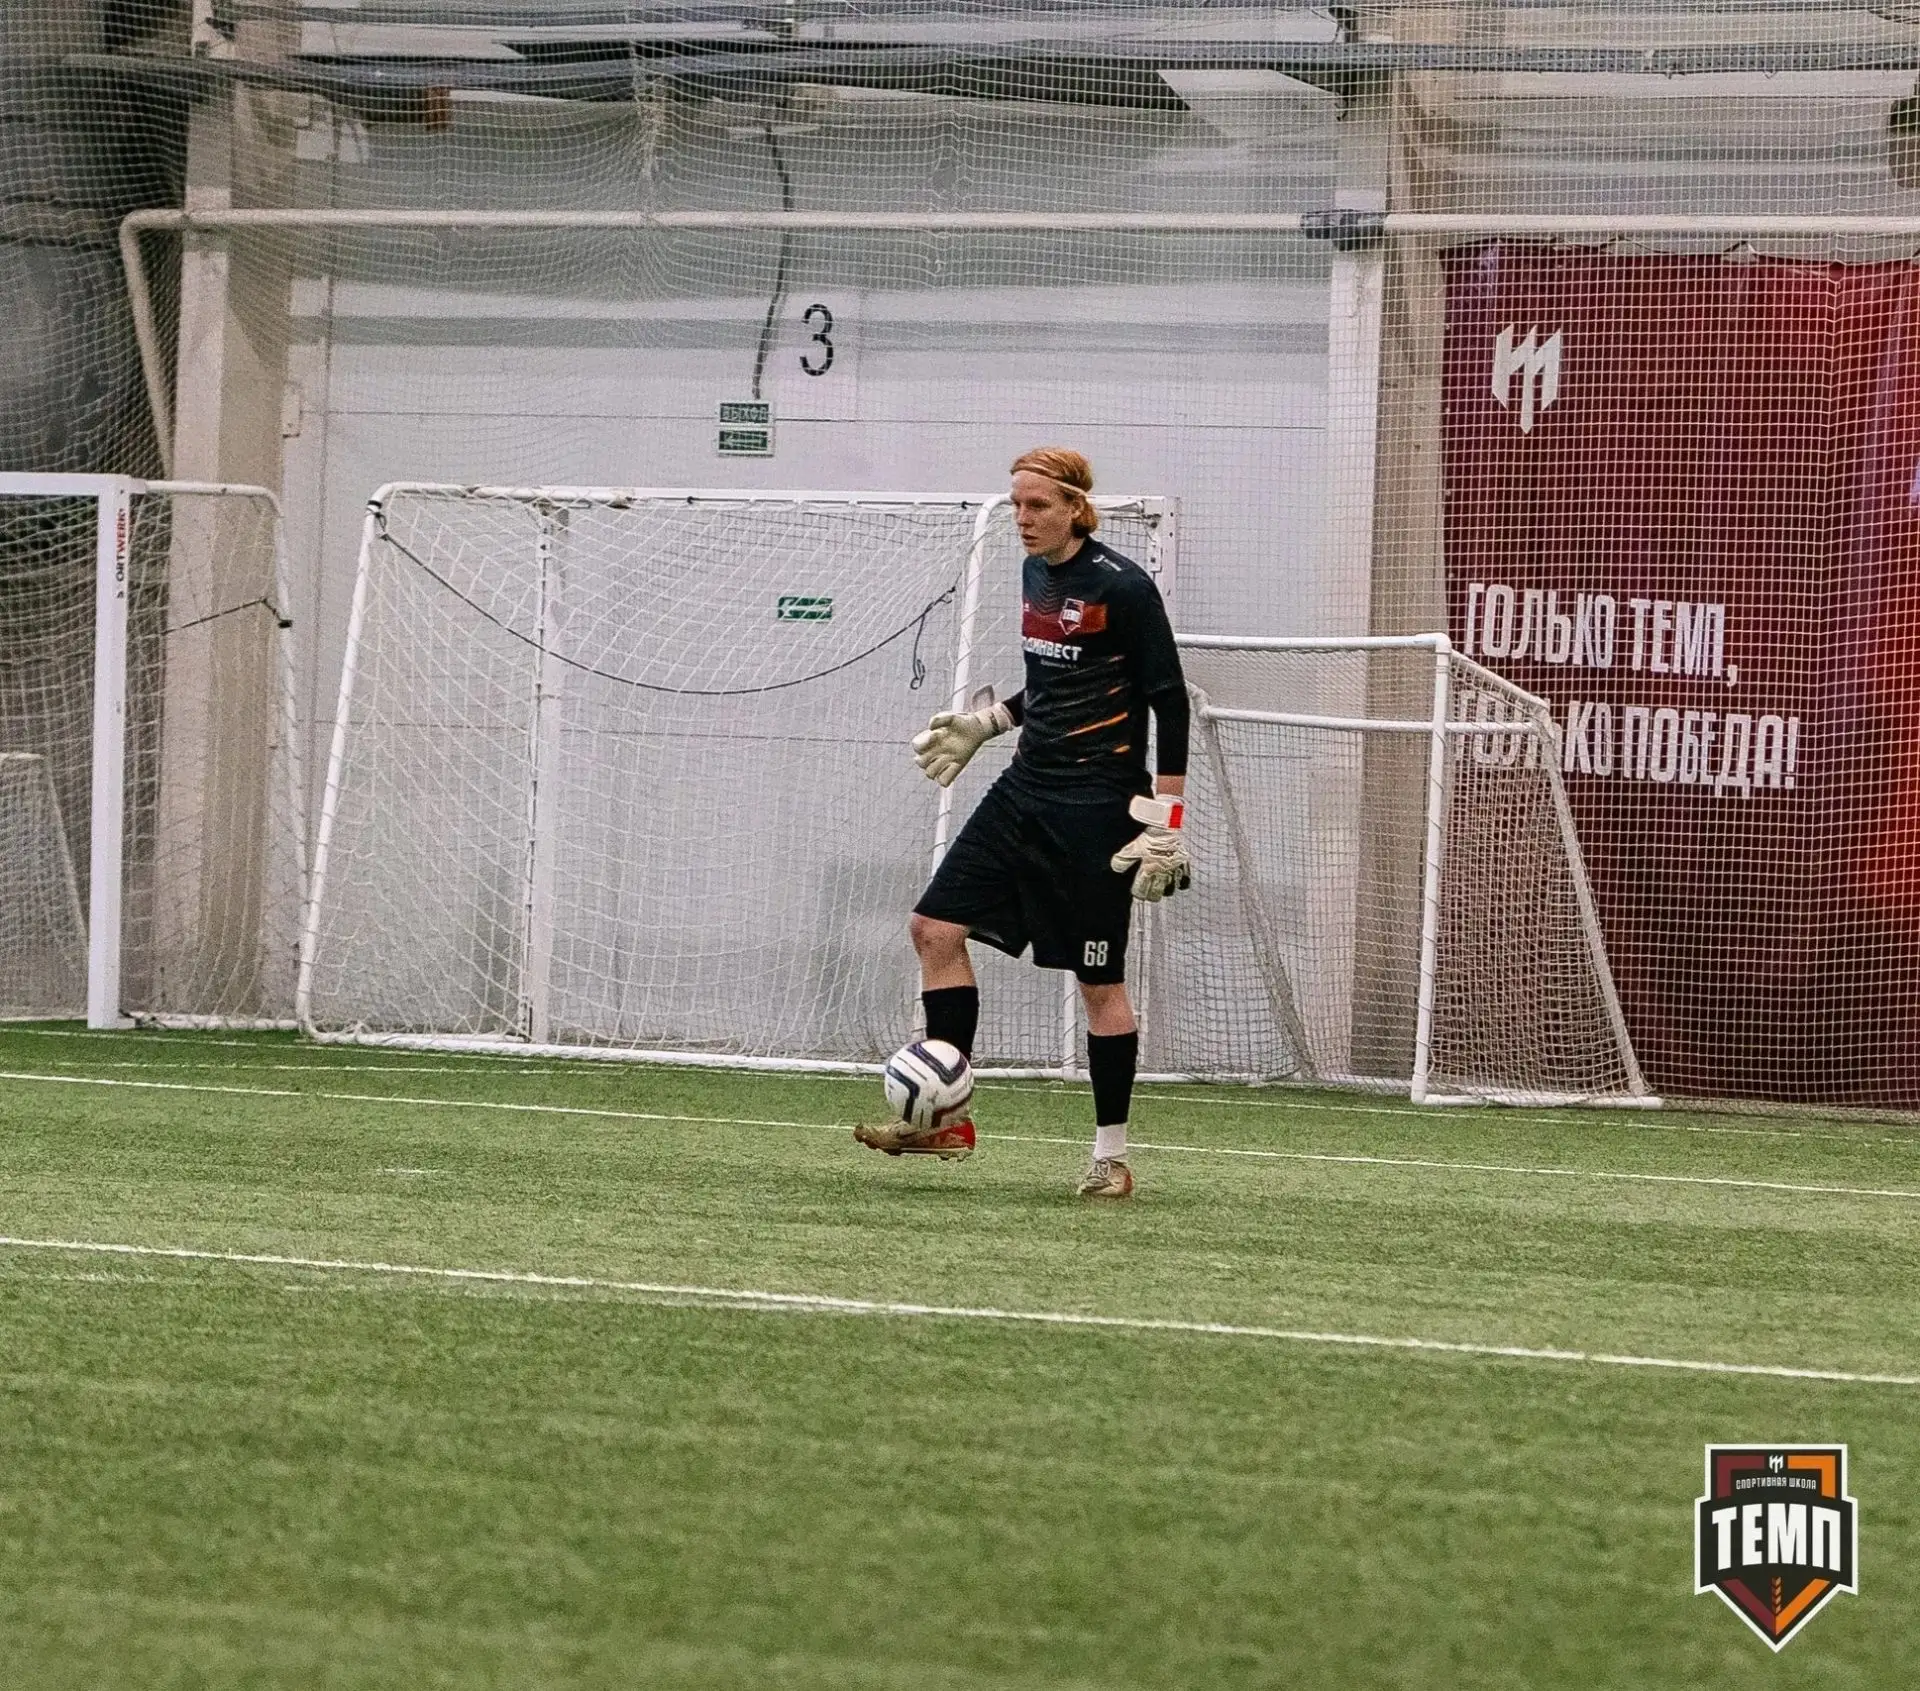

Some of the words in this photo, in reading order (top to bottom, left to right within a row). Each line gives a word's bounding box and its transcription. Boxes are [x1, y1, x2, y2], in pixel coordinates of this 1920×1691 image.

[800, 303, 834, 376] 3
[116, 508, 126, 599] SORTWERK
[1630, 598, 1738, 686] ТЕМП,
[1623, 706, 1799, 799] ПОБЕДА!
[1083, 940, 1109, 967] 68
